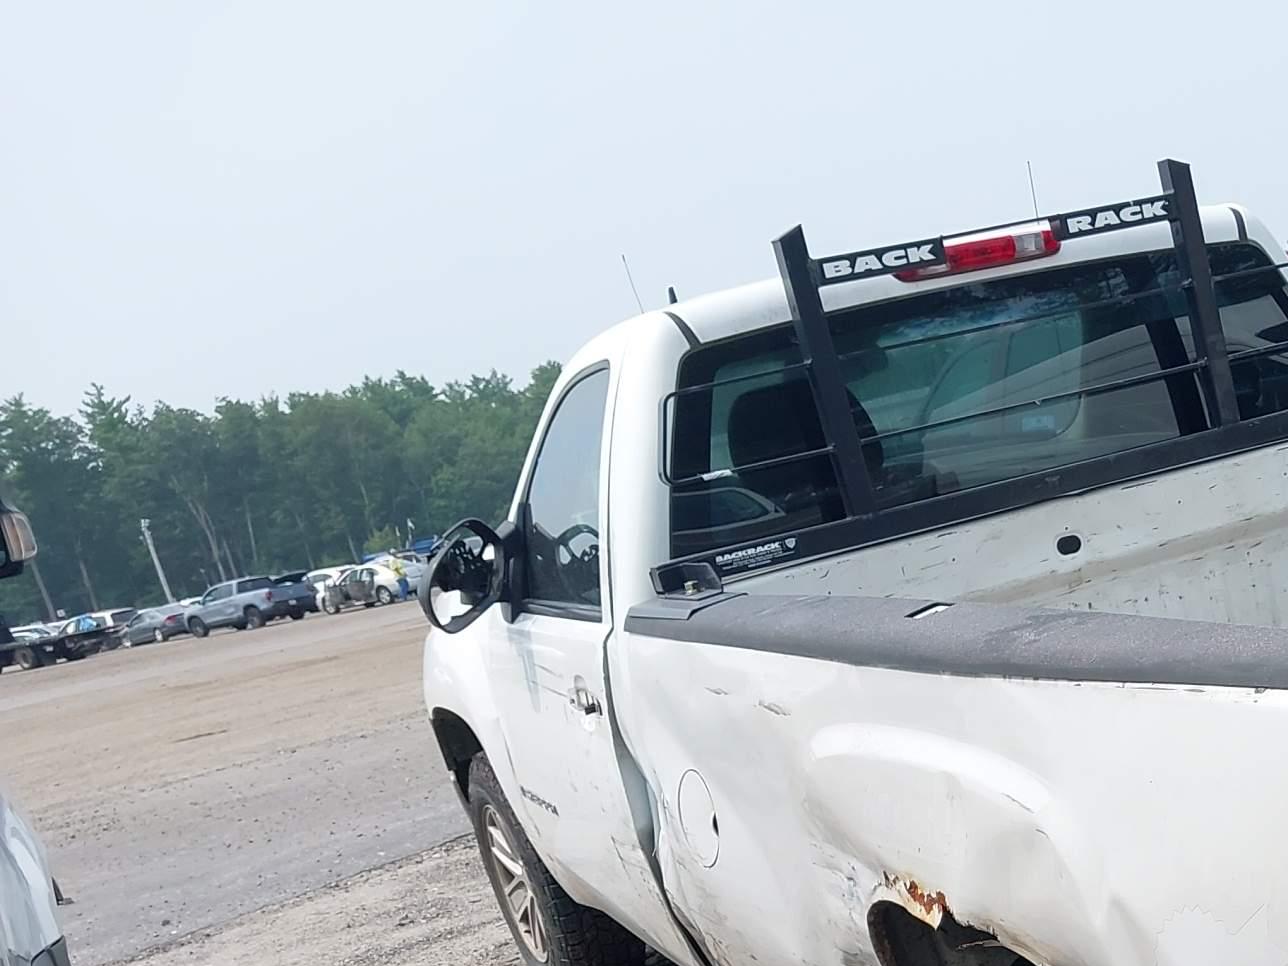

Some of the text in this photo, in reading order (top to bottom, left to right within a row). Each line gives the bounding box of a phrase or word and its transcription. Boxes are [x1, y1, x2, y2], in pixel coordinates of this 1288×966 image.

[822, 200, 1169, 280] BACK RACK
[715, 541, 782, 563] BACKRACK
